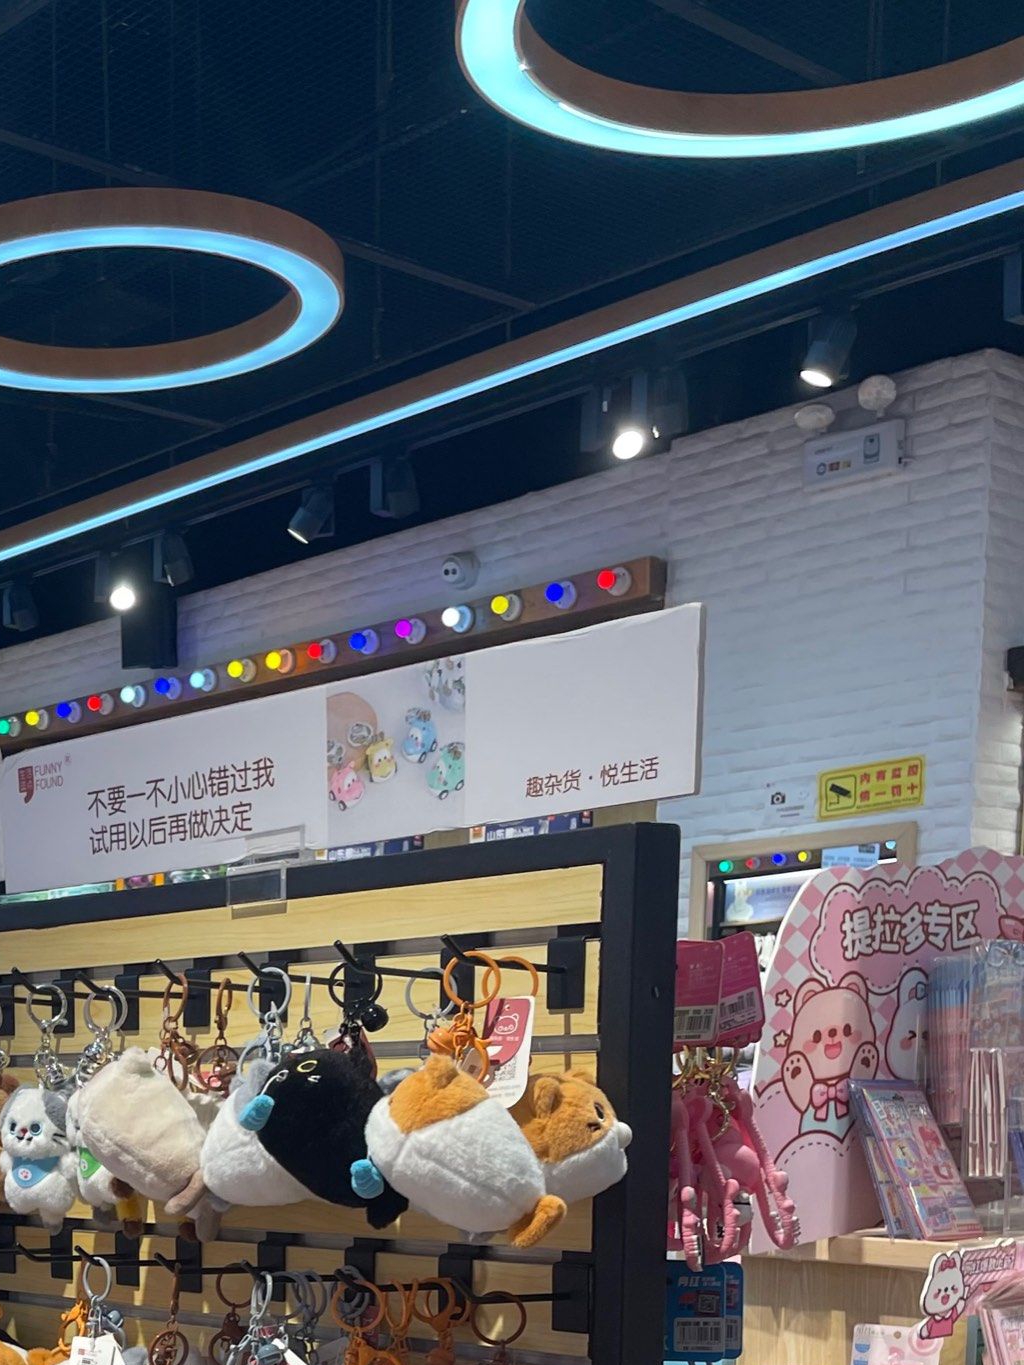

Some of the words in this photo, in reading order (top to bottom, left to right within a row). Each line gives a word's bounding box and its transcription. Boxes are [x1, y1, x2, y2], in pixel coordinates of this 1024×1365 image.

[34, 761, 63, 778] FUNNY
[36, 776, 64, 791] FOUND
[87, 757, 275, 815] 不要一不小心错过我
[88, 801, 254, 857] 试用以后再做决定
[841, 901, 981, 961] 提拉多专区
